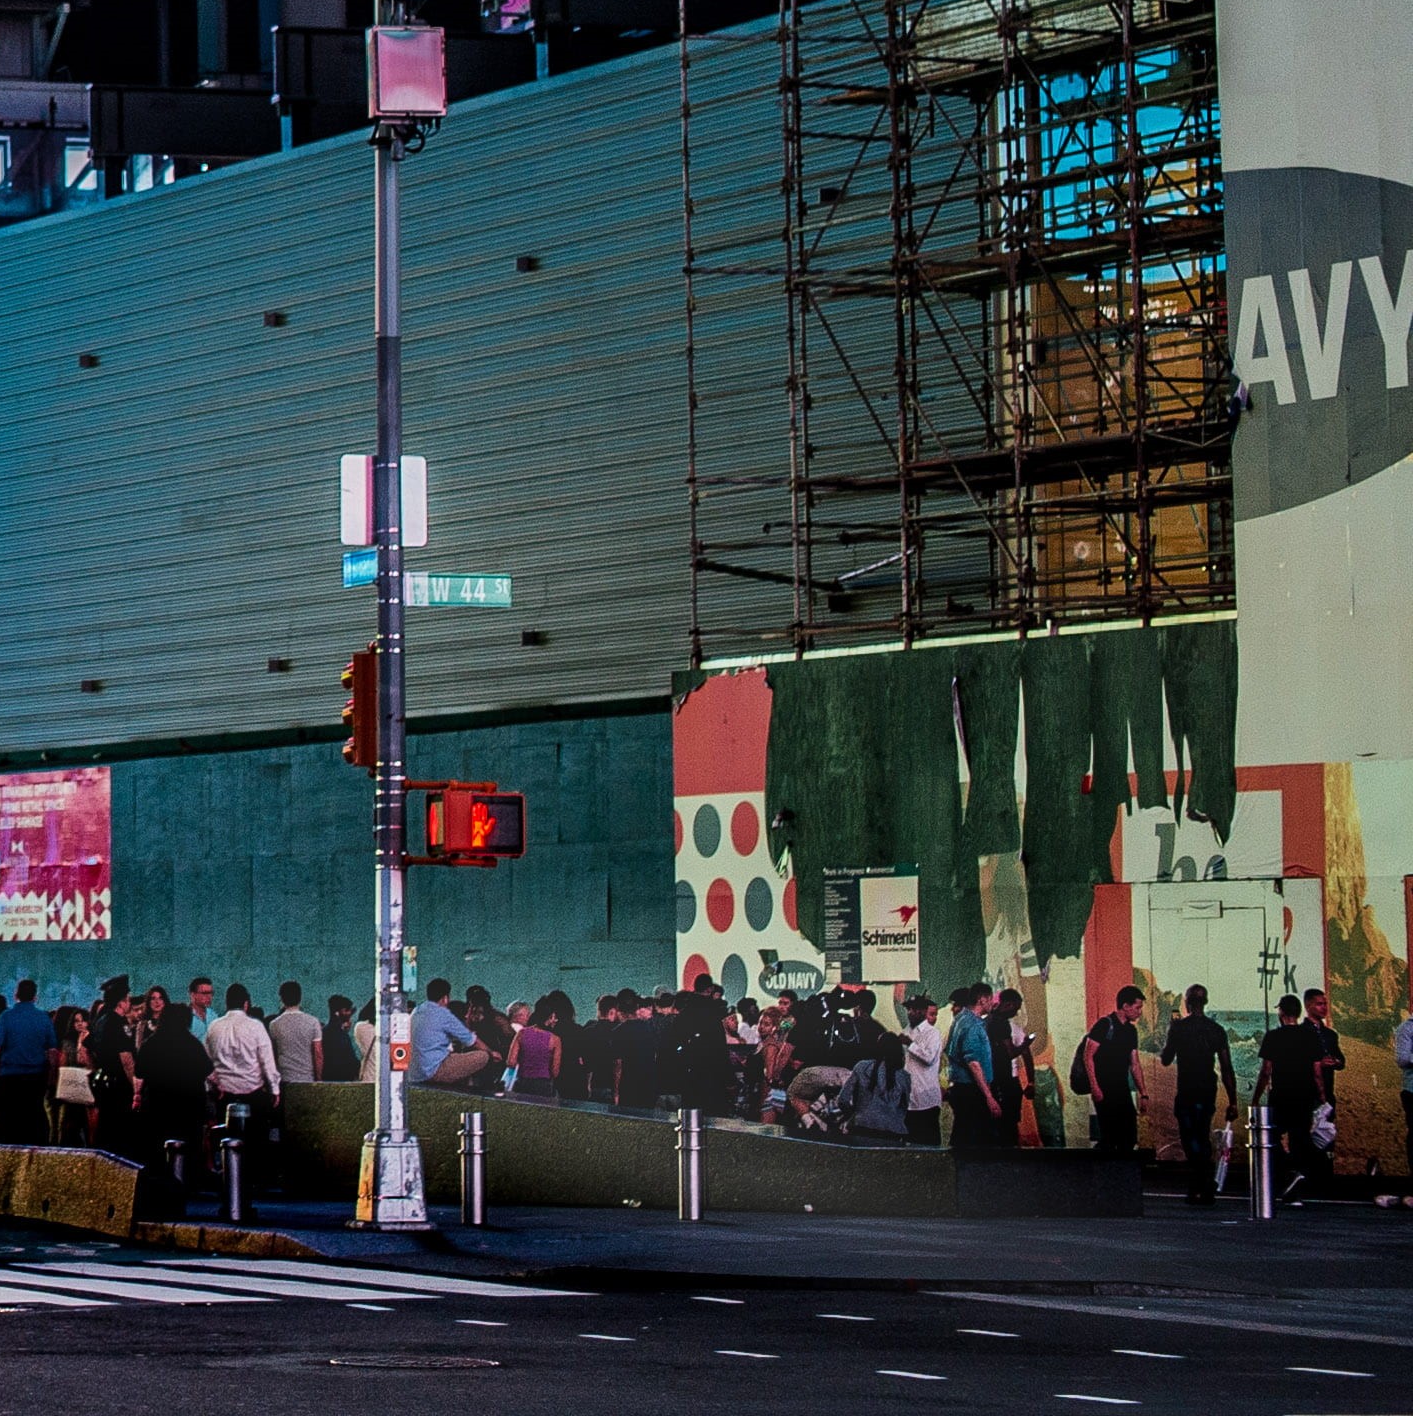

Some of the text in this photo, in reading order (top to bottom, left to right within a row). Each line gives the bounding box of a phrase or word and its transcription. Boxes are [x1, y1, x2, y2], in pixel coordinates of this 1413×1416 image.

[1234, 248, 1413, 406] AVY
[432, 577, 451, 603] W
[459, 577, 486, 604] 44
[862, 928, 917, 947] Schimenti
[787, 972, 818, 990] NAVY
